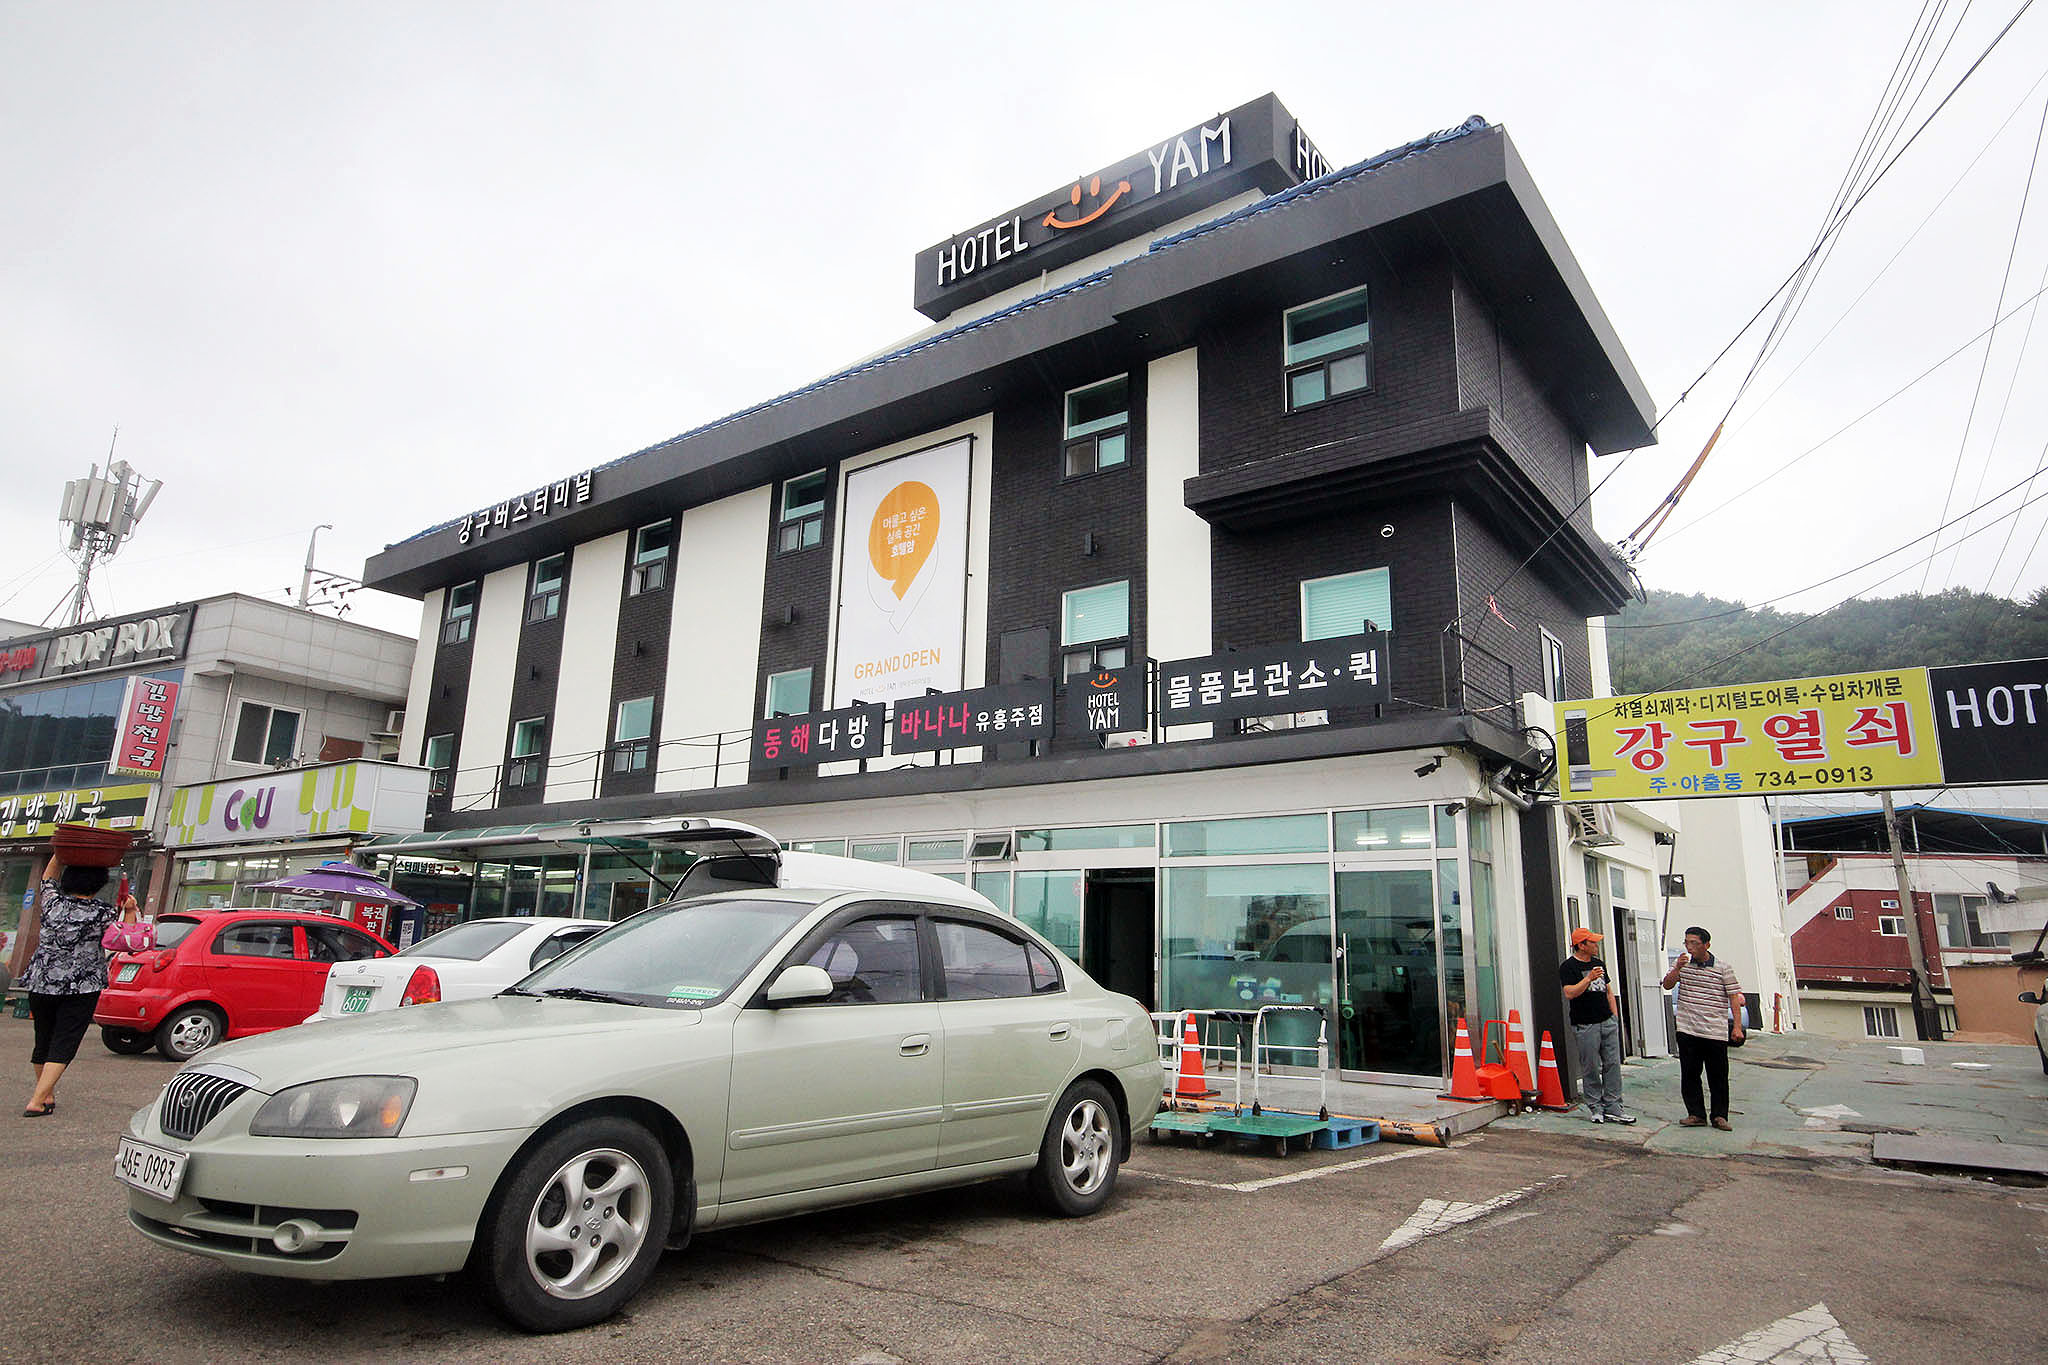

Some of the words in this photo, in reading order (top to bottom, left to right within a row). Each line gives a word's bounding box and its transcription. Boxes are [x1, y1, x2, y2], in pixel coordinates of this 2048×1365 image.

[937, 215, 1029, 287] HOTEL
[1147, 116, 1232, 194] YAM
[458, 469, 593, 545] 강구버스터미널
[52, 626, 114, 668] HOF
[112, 613, 182, 658] BOX
[854, 656, 901, 680] GRAND
[902, 648, 941, 669] OPEN
[1087, 692, 1120, 709] HOTEL
[1087, 708, 1119, 731] YAM
[1946, 683, 2048, 729] HOT
[129, 680, 168, 768] 김밥천국
[900, 702, 971, 740] 바나나
[975, 703, 1043, 732] 유흥주점
[1614, 702, 1913, 772] 강구열쇠
[1754, 766, 1874, 788] 734-0913
[342, 996, 370, 1012] 6077
[143, 1153, 176, 1191] 0993
